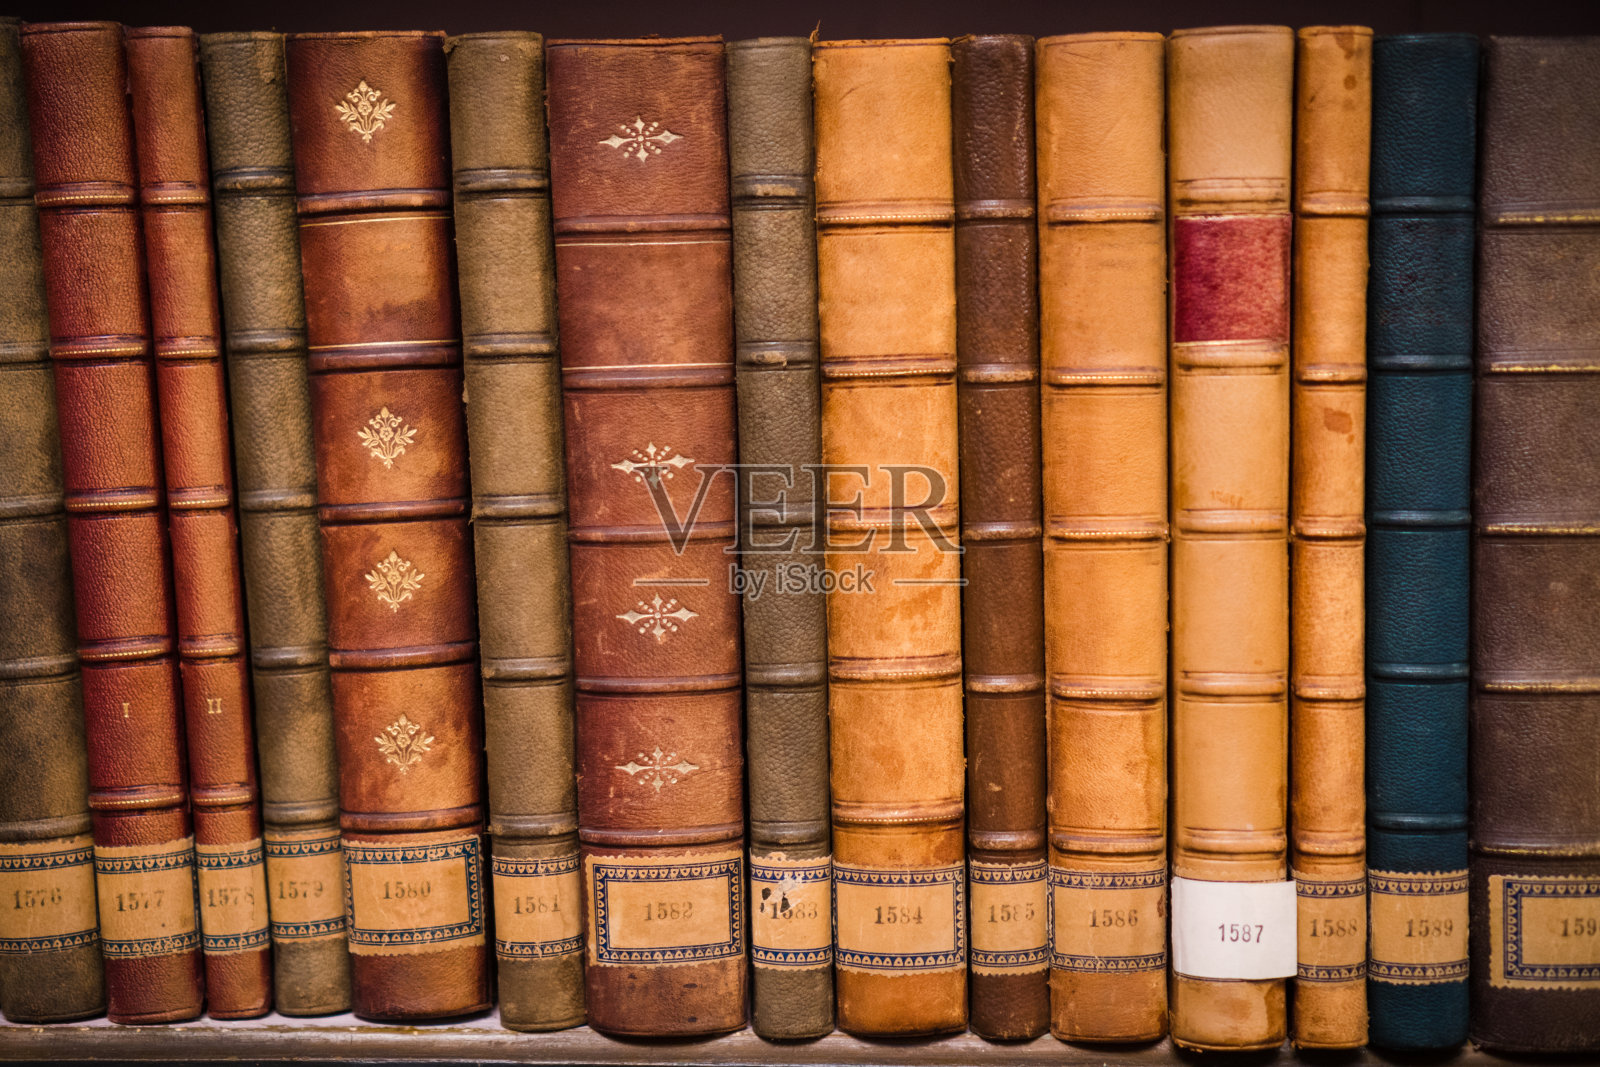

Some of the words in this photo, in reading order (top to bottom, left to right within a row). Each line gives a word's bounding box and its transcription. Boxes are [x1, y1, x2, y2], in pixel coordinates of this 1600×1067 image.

[206, 887, 255, 909] 1578
[278, 880, 324, 900] 1579
[383, 881, 432, 900] 1580
[115, 890, 166, 912] 1577
[513, 895, 562, 916] 1581
[644, 902, 693, 921] 1582
[874, 905, 923, 925] 1584
[1088, 909, 1139, 928] 1586
[1218, 923, 1264, 945] 1587
[1310, 919, 1358, 938] 1588
[1405, 919, 1454, 938] 1589
[1560, 918, 1600, 937] 159
